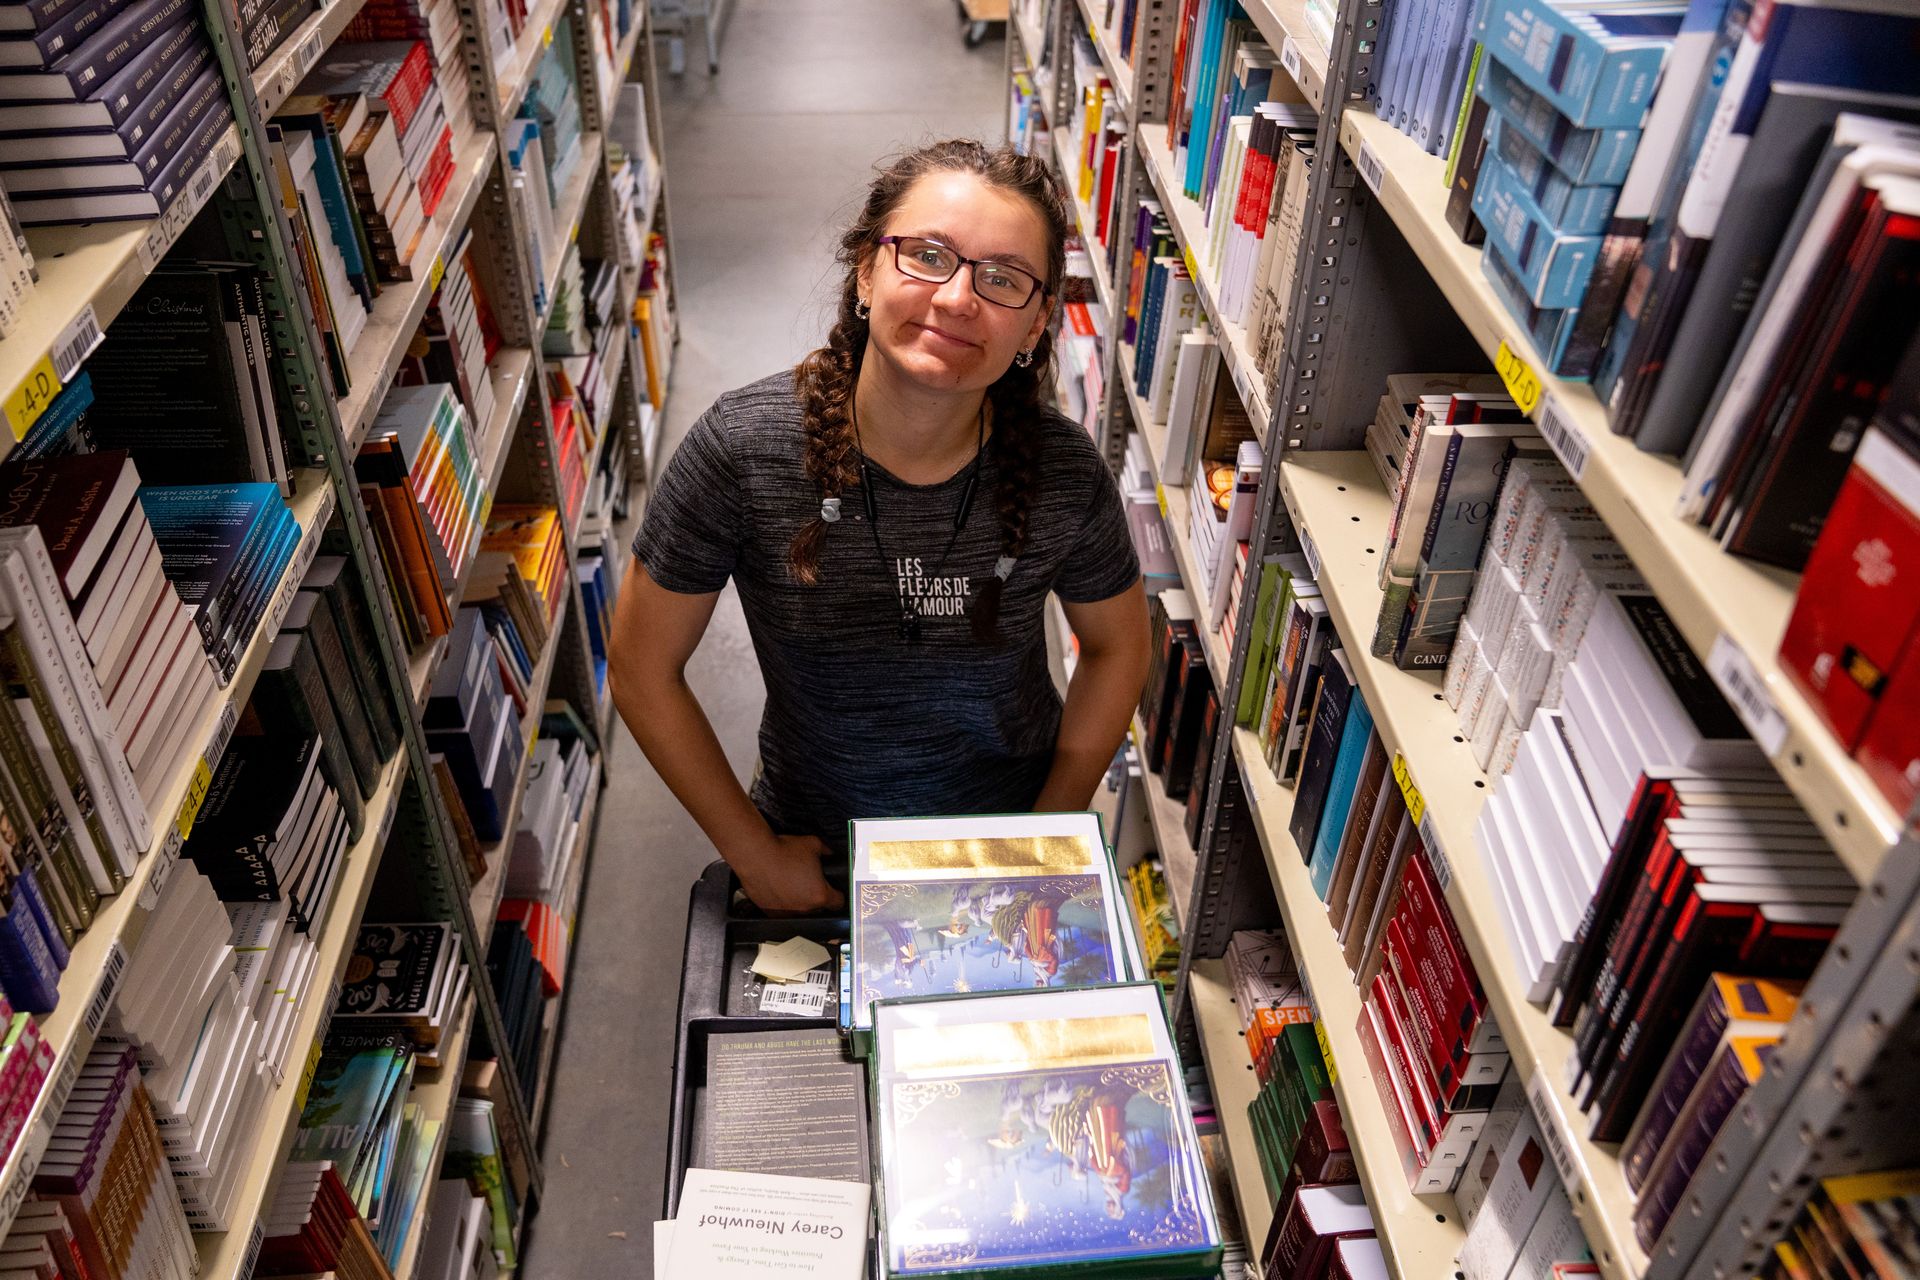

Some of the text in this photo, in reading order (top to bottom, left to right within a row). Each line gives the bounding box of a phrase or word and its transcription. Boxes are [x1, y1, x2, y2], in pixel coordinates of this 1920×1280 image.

[106, 40, 129, 62] WILLARD
[248, 37, 264, 67] THE
[146, 296, 204, 314] Christmas
[234, 282, 255, 366] AUTHENTIC LIVES
[253, 276, 272, 359] AUTHENTIC LIVES
[52, 526, 78, 550] David
[76, 481, 102, 511] deSilva
[897, 558, 922, 577] LES
[900, 577, 971, 597] FLEURS DE
[36, 550, 101, 712] BEAUTY BY DESIGN
[18, 572, 85, 736] BEAUTY BY DESIGN
[407, 977, 424, 1009] RACHEL
[1264, 1010, 1311, 1026] SPEN
[340, 1036, 394, 1047] SAMUEL
[786, 1040, 800, 1048] HAVE
[318, 1125, 359, 1148] ALL
[698, 1214, 843, 1239] Carey Nieuwhof
[712, 1243, 731, 1251] Favor
[760, 1247, 790, 1257] Working
[791, 1251, 823, 1259] Priorities
[726, 1256, 750, 1265] Energy
[752, 1259, 771, 1268] Time,
[773, 1261, 787, 1269] Get
